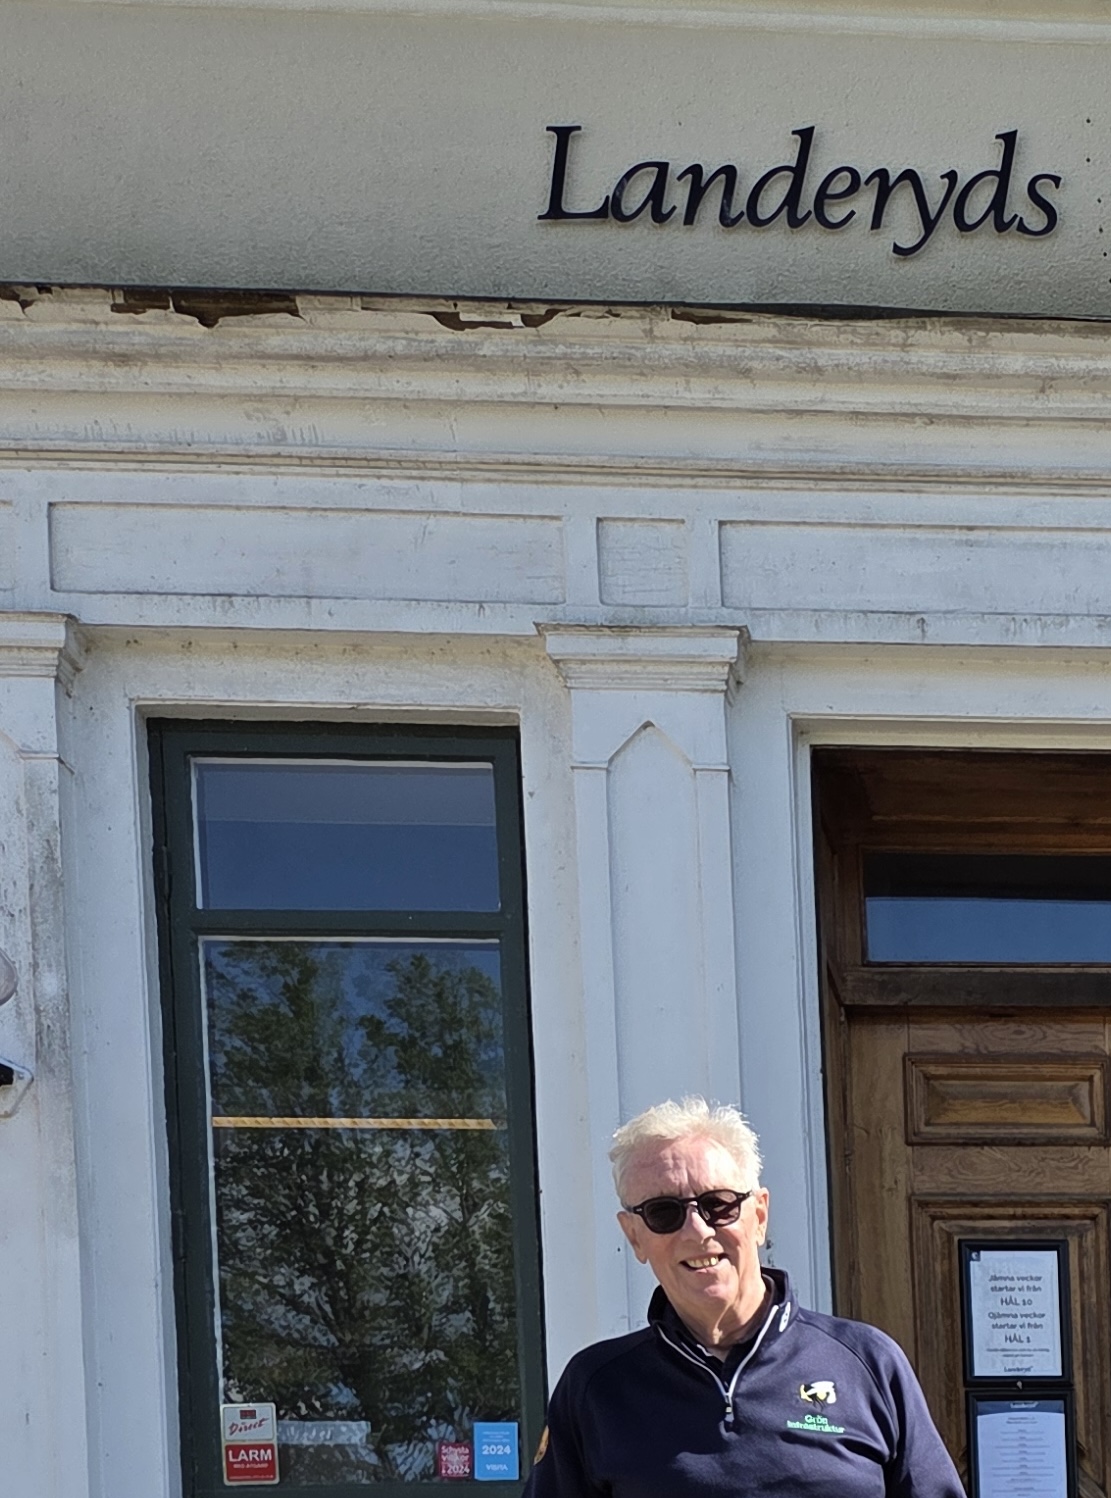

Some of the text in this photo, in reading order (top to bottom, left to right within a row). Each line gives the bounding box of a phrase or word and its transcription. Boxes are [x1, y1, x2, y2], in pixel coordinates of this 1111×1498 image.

[538, 125, 1062, 257] Landeryds
[1016, 1274, 1042, 1282] veckor
[1000, 1295, 1020, 1306] HÅL
[1019, 1311, 1046, 1319] veckor
[1004, 1333, 1024, 1344] HÅL
[482, 1444, 511, 1455] 2024
[228, 1449, 272, 1462] LARM
